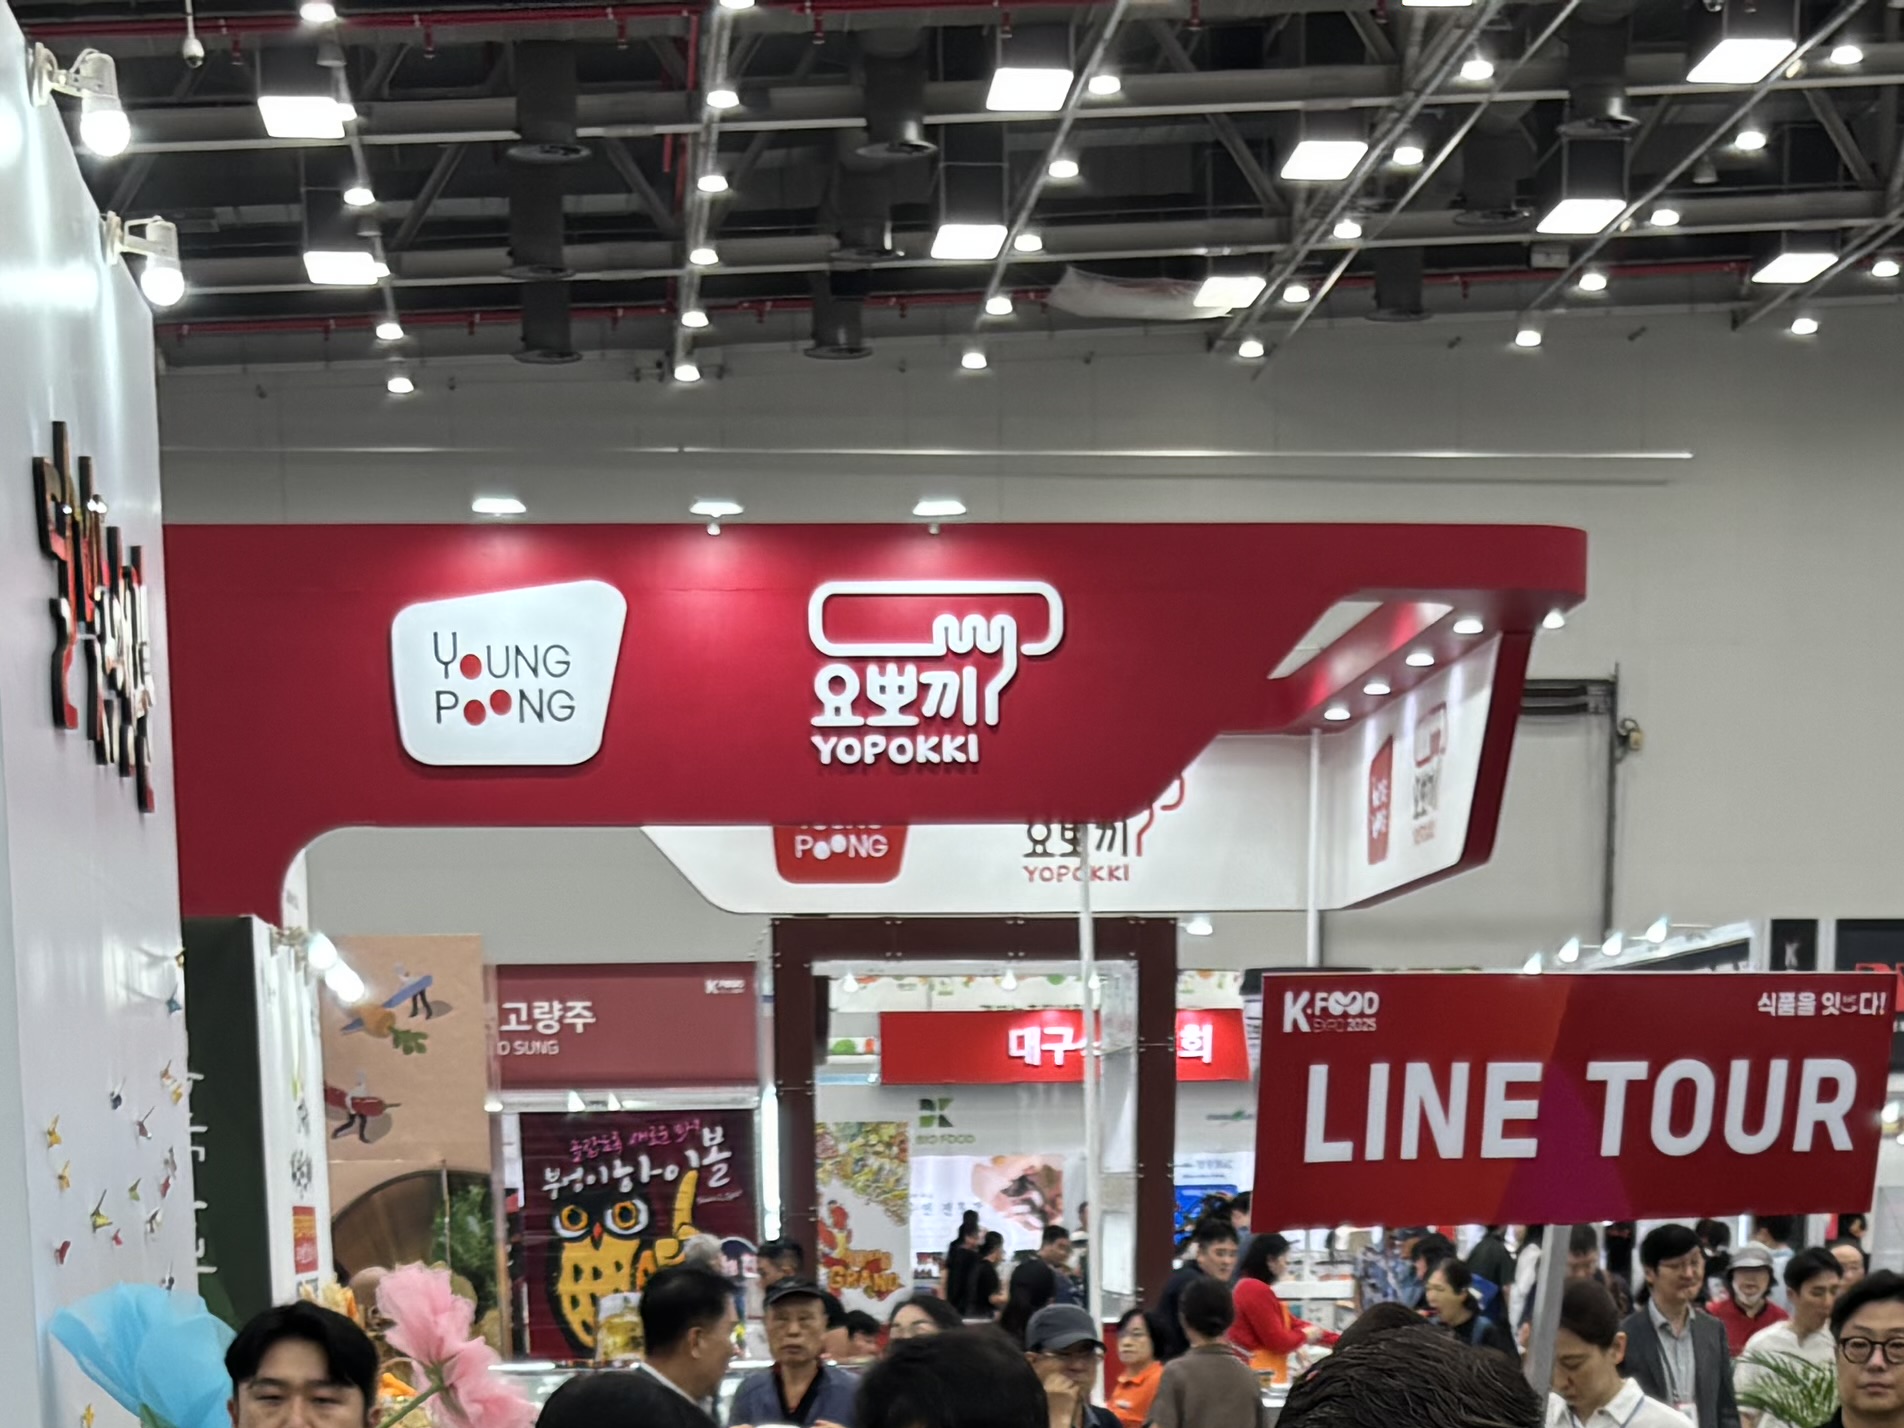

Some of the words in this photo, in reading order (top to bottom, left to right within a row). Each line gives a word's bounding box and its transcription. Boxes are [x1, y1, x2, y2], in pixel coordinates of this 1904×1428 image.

[432, 630, 572, 680] YOUNG
[435, 689, 576, 726] POONG
[810, 666, 978, 727] 요뽀끼
[810, 733, 980, 766] YOPOKKI
[795, 834, 889, 860] POONG
[1757, 992, 1816, 1017] 식품을
[512, 1040, 560, 1056] SUNG
[1303, 1061, 1543, 1164] LINE
[1585, 1058, 1857, 1158] TOUR
